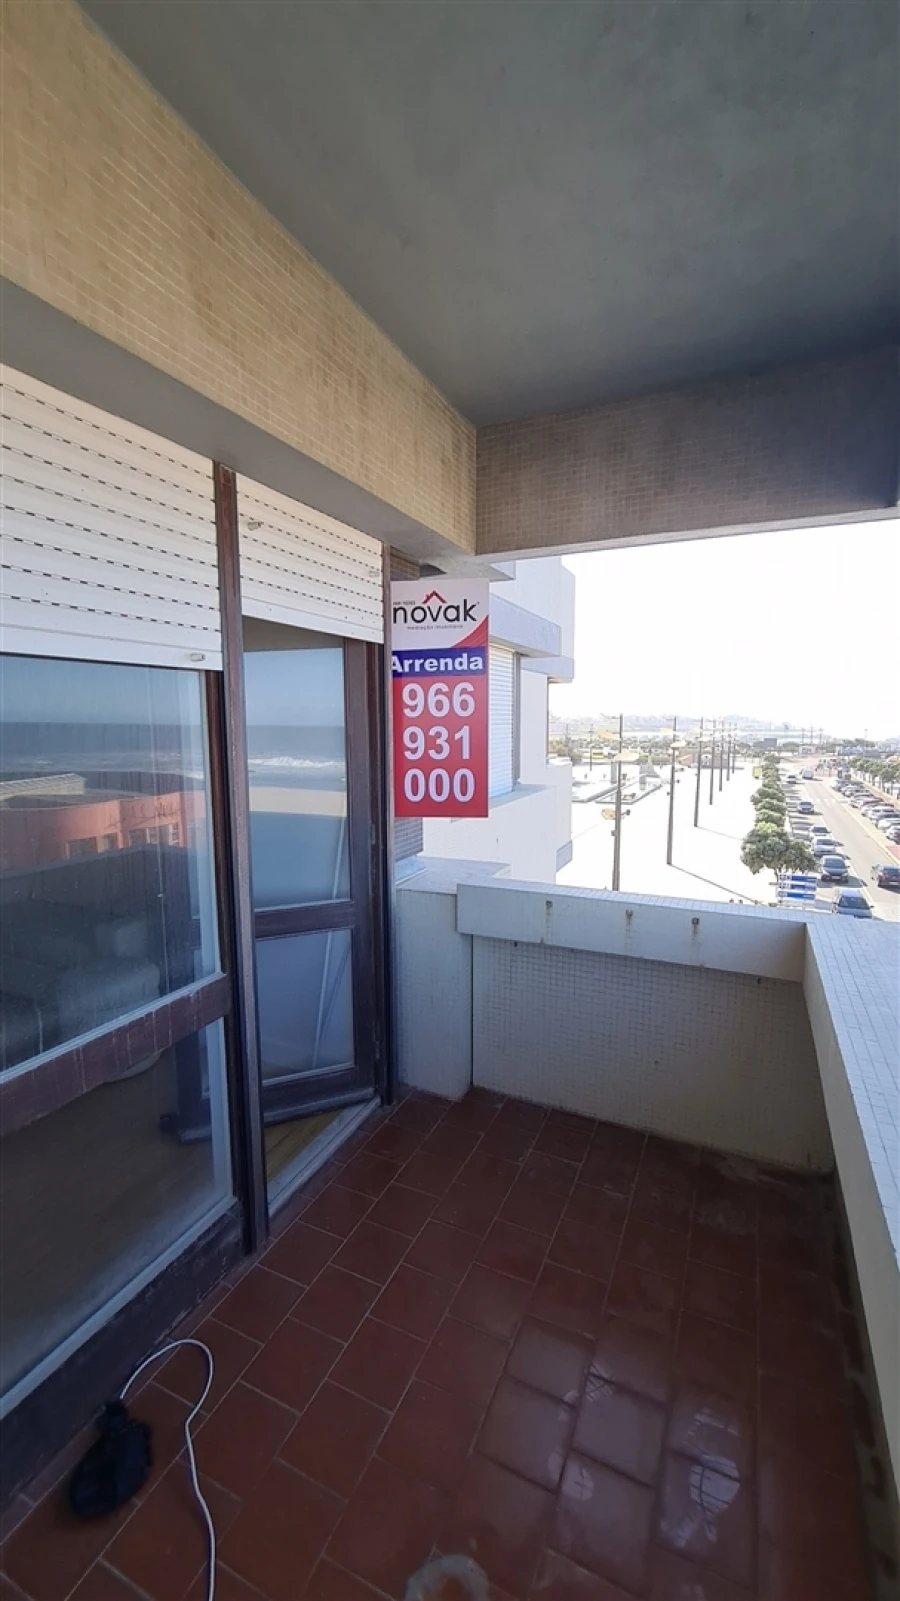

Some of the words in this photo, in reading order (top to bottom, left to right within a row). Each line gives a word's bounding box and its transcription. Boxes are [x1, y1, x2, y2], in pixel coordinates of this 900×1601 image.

[393, 599, 477, 624] novak
[392, 653, 483, 673] Arrenda
[402, 682, 475, 717] 966
[403, 725, 471, 760] 931
[404, 768, 475, 803] 000
